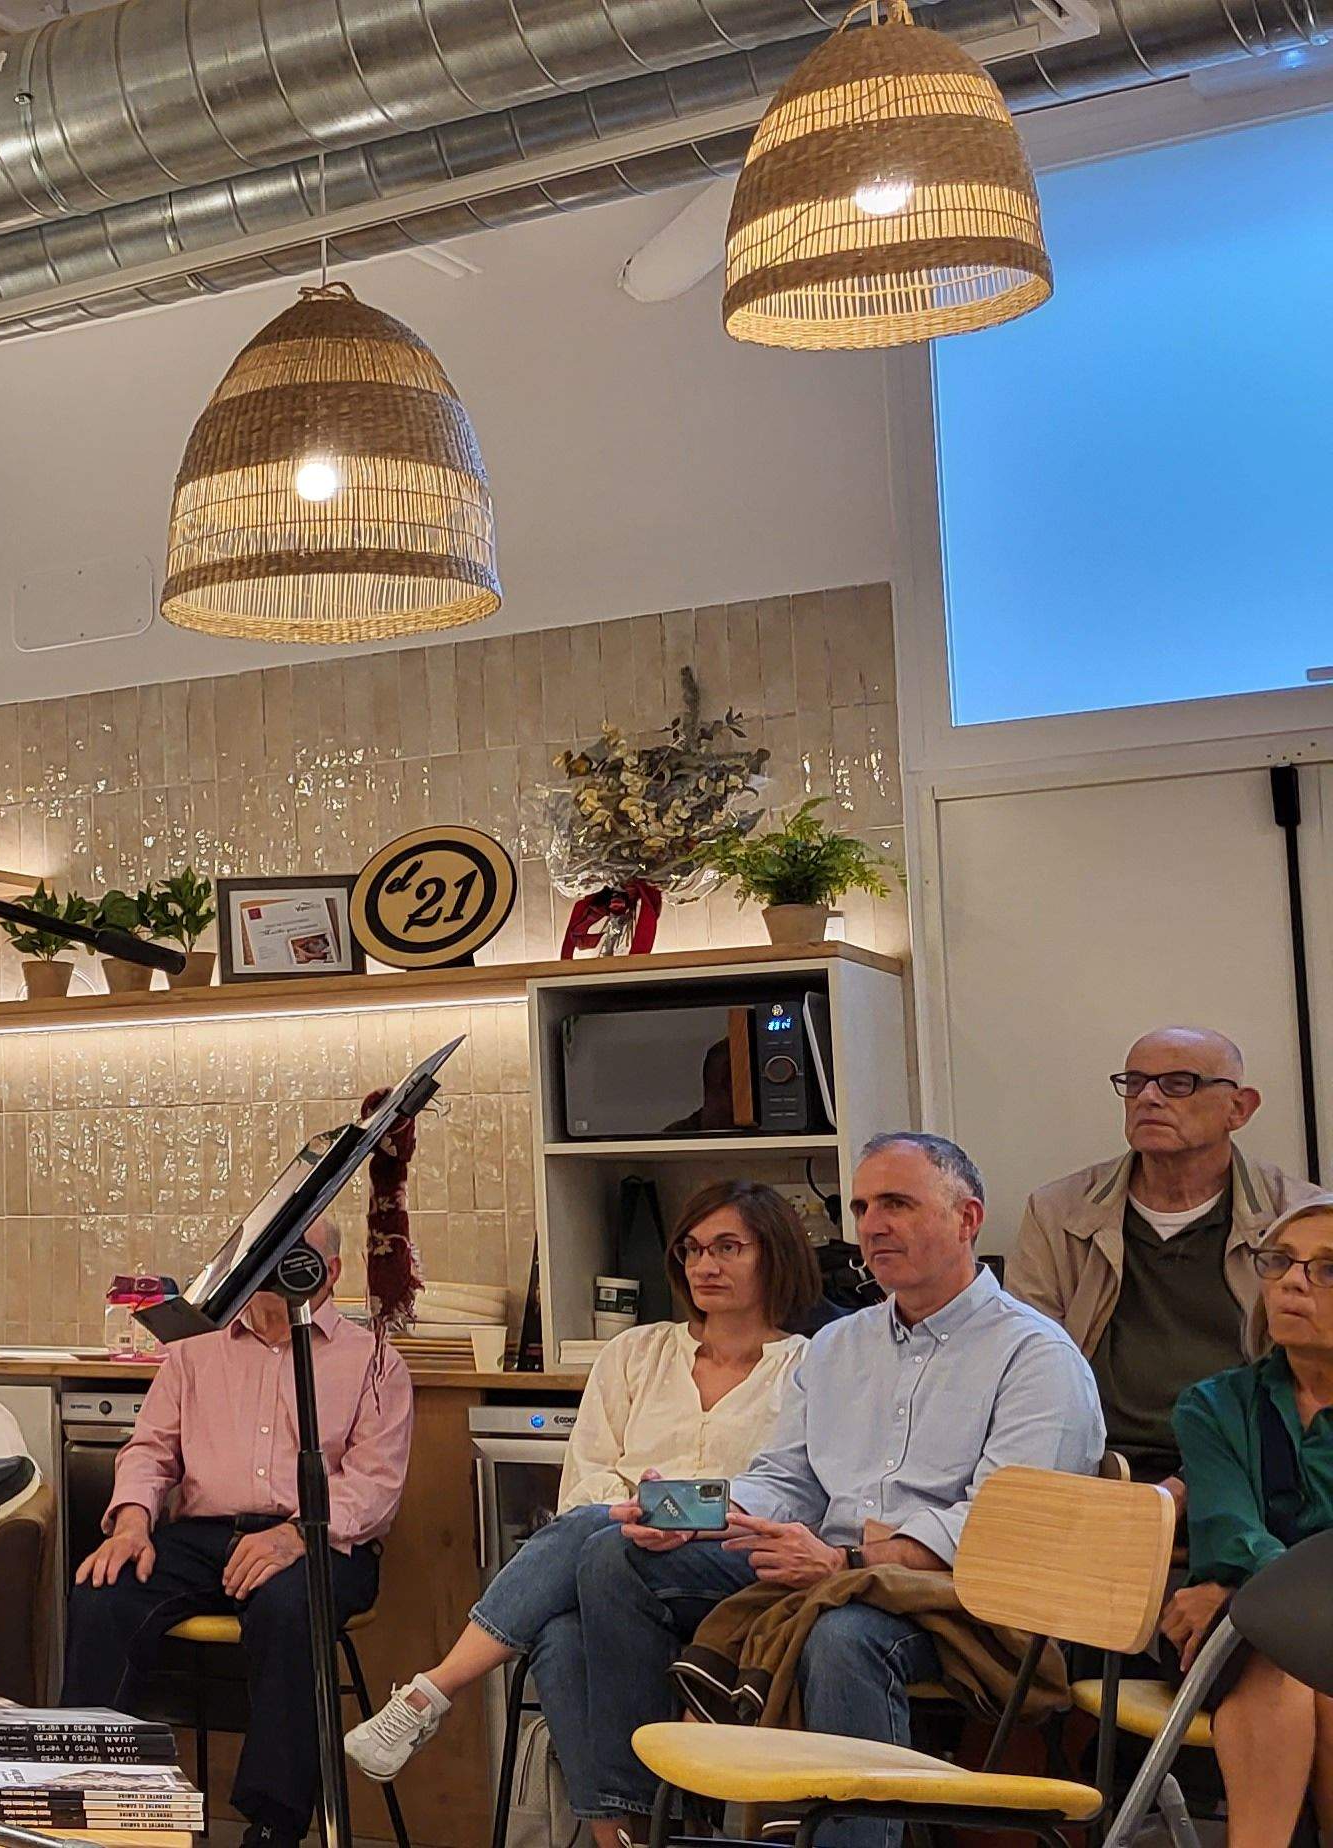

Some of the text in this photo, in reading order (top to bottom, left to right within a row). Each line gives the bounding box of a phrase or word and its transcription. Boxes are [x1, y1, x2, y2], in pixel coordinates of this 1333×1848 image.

[104, 1725, 133, 1733] JUAN
[33, 1735, 58, 1743] verso
[71, 1735, 97, 1743] Verso
[104, 1735, 136, 1743] JUAN
[106, 1745, 138, 1753] JUAN
